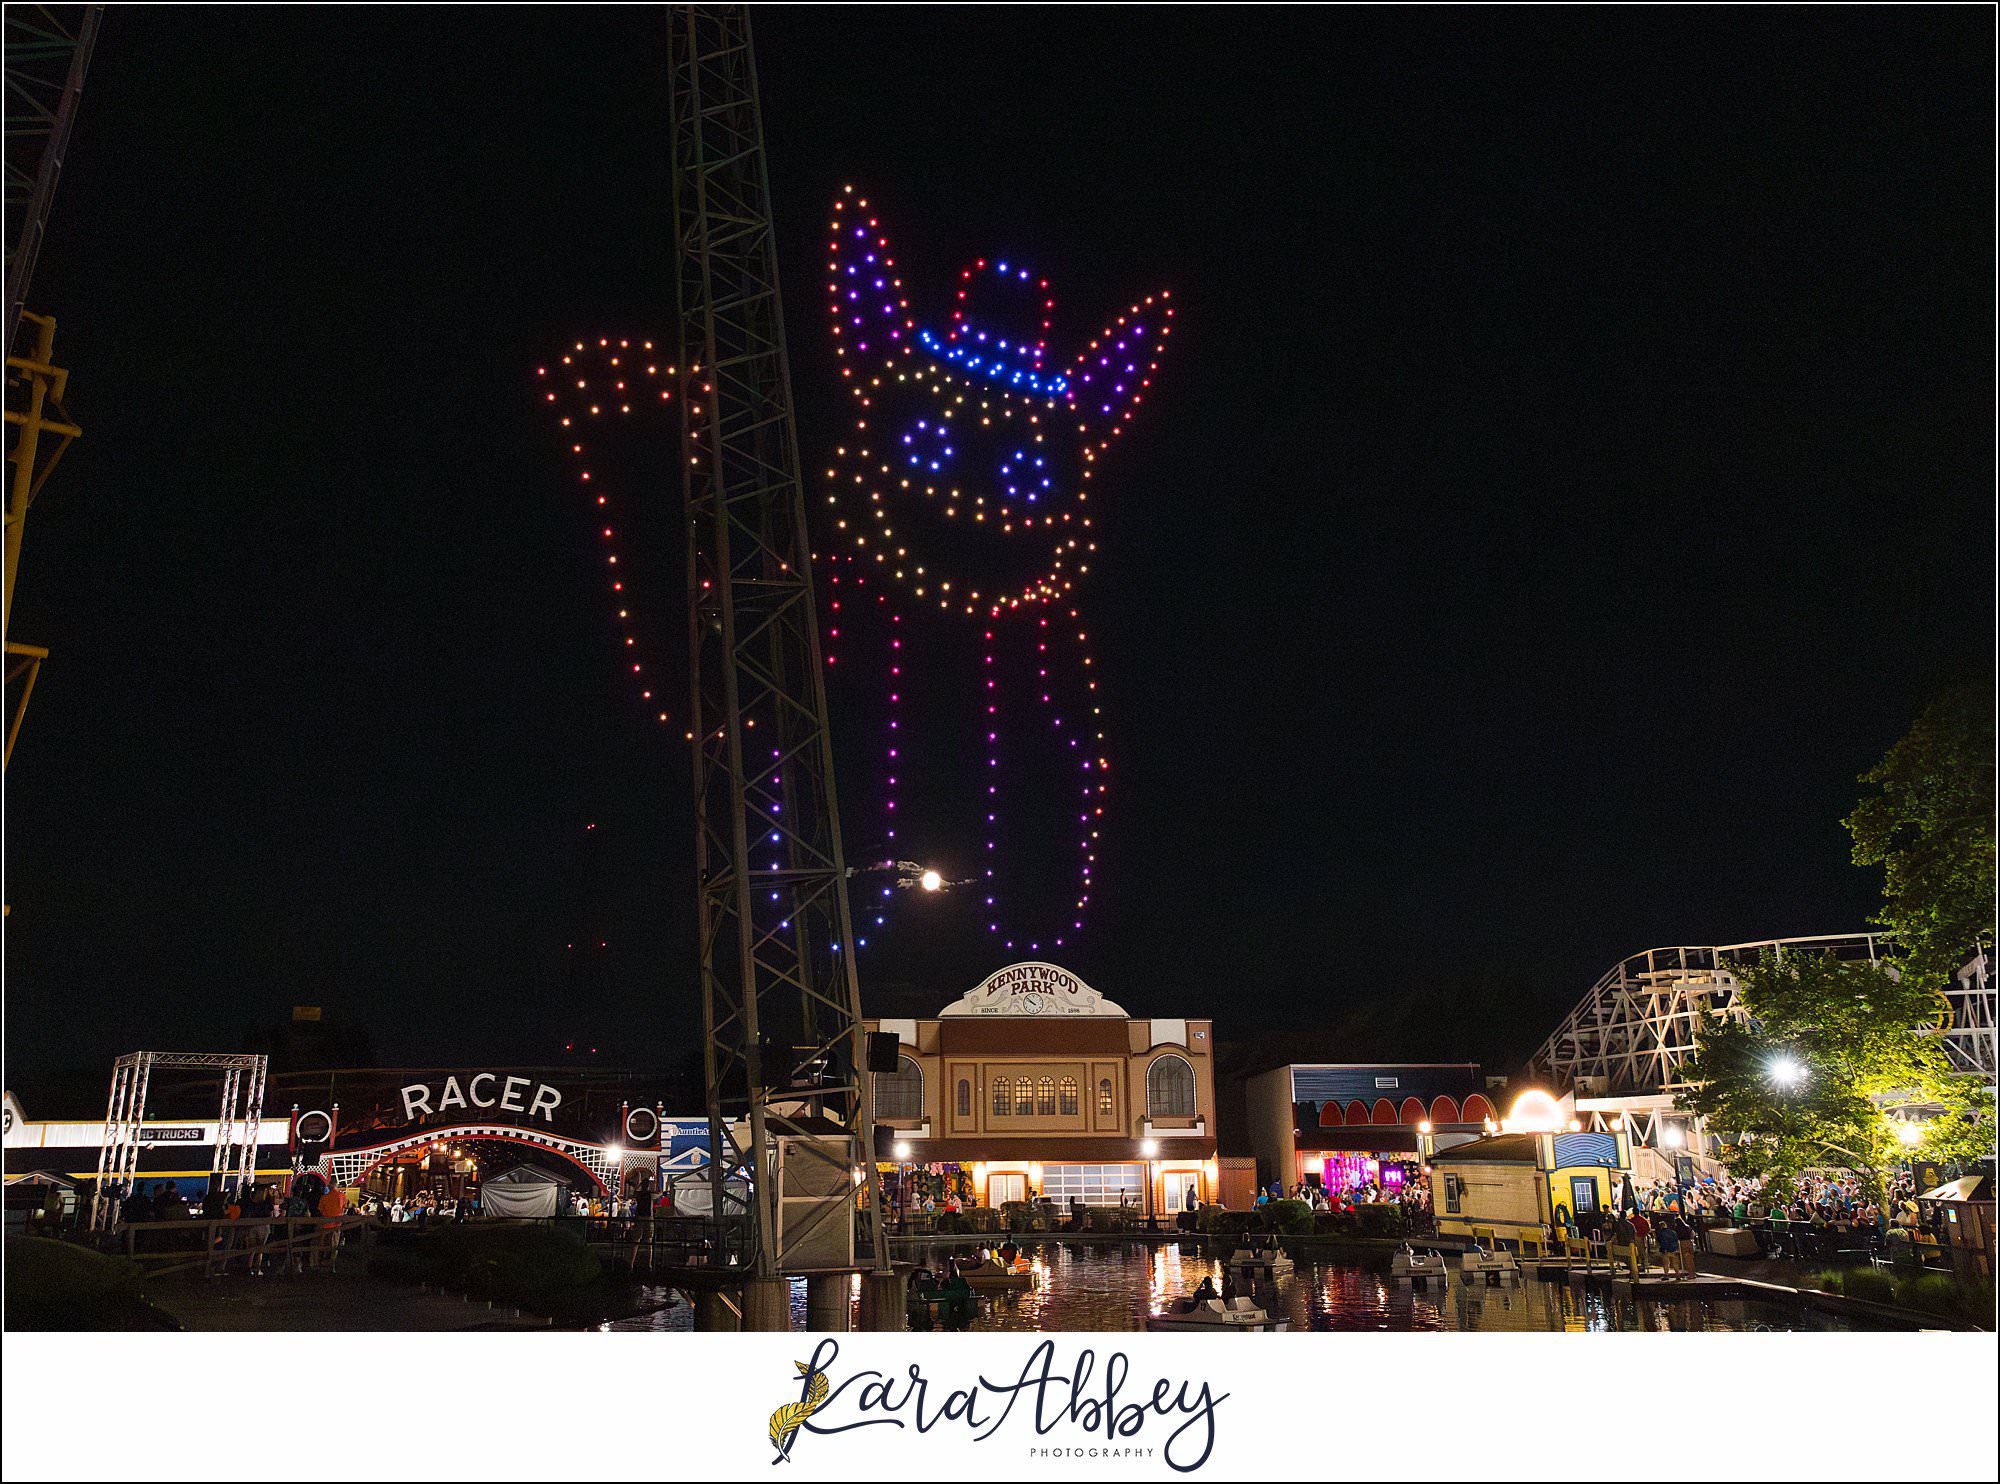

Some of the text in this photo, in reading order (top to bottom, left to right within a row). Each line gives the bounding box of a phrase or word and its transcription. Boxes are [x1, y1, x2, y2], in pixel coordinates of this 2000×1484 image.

[986, 966, 1079, 997] KENNYWOOD
[1011, 980, 1055, 996] PARK
[400, 1072, 562, 1122] RACER
[155, 1129, 200, 1140] TRUCKS
